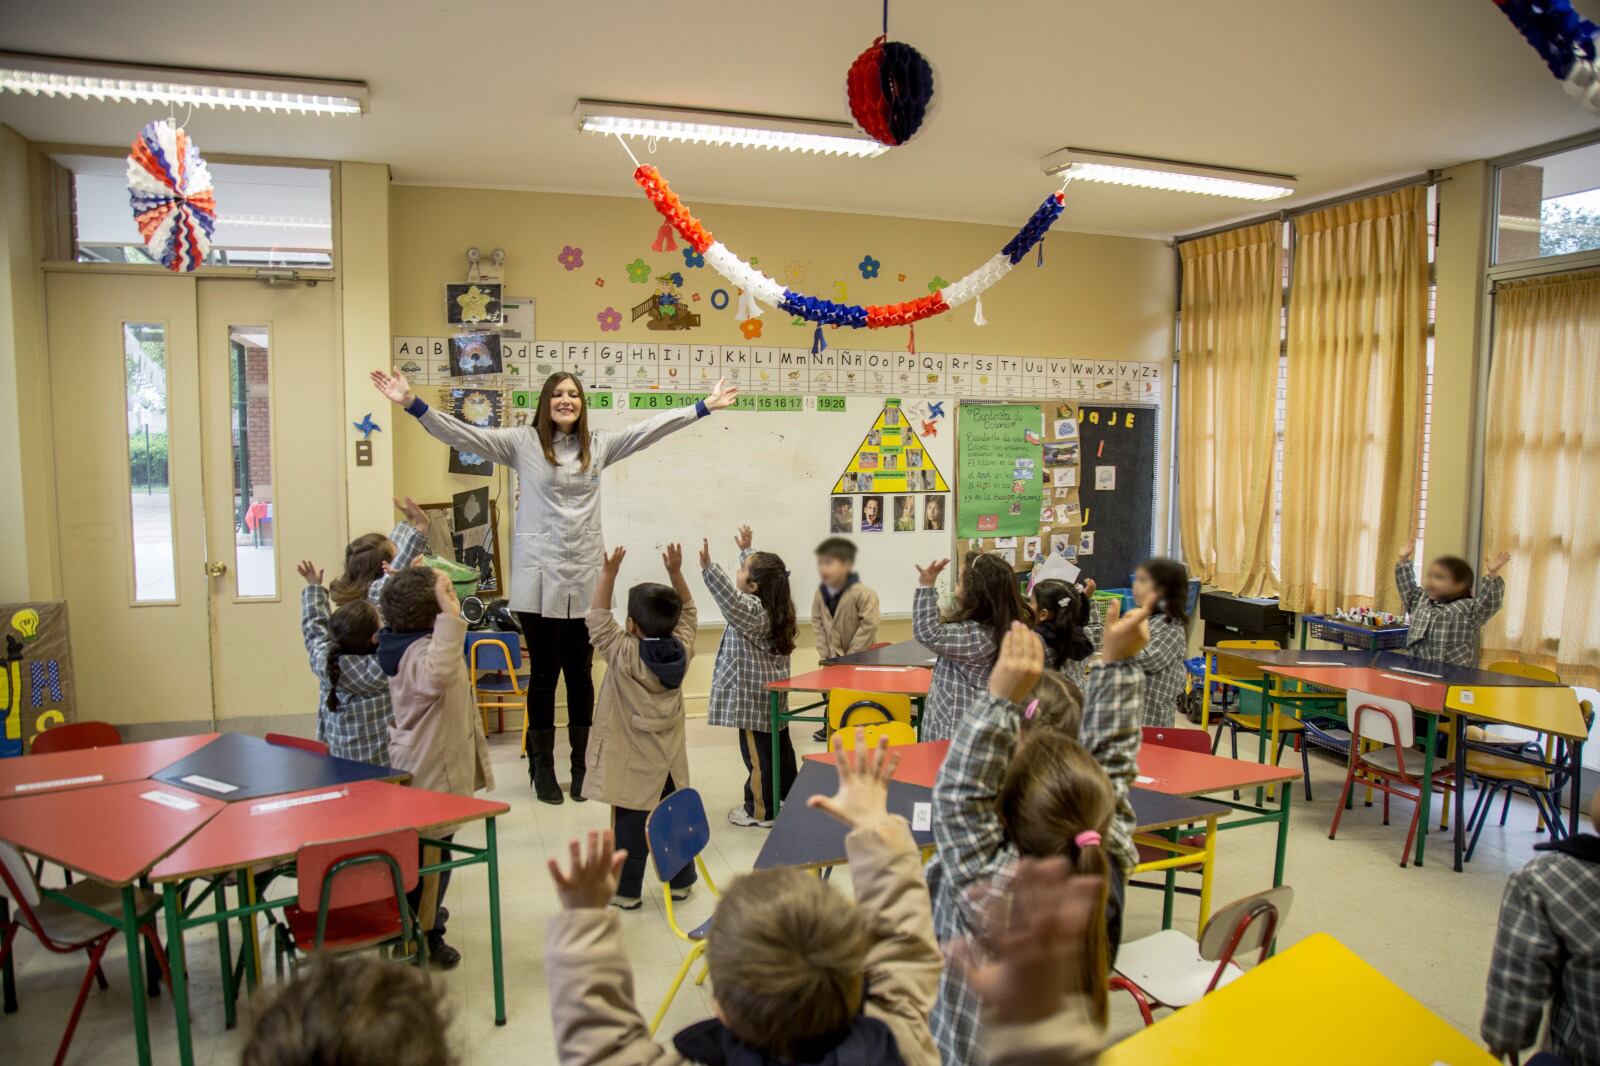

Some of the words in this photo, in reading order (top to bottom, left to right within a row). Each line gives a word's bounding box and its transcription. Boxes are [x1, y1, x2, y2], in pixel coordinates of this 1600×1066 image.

[601, 396, 609, 407] 5
[634, 396, 641, 407] 7
[649, 396, 657, 408] 8
[665, 395, 673, 406] 9
[679, 396, 692, 407] 10
[742, 398, 754, 407] 14
[760, 398, 771, 408] 15
[773, 398, 787, 408] 16
[788, 398, 802, 408] 17
[818, 399, 831, 408] 19
[832, 399, 845, 409] 20
